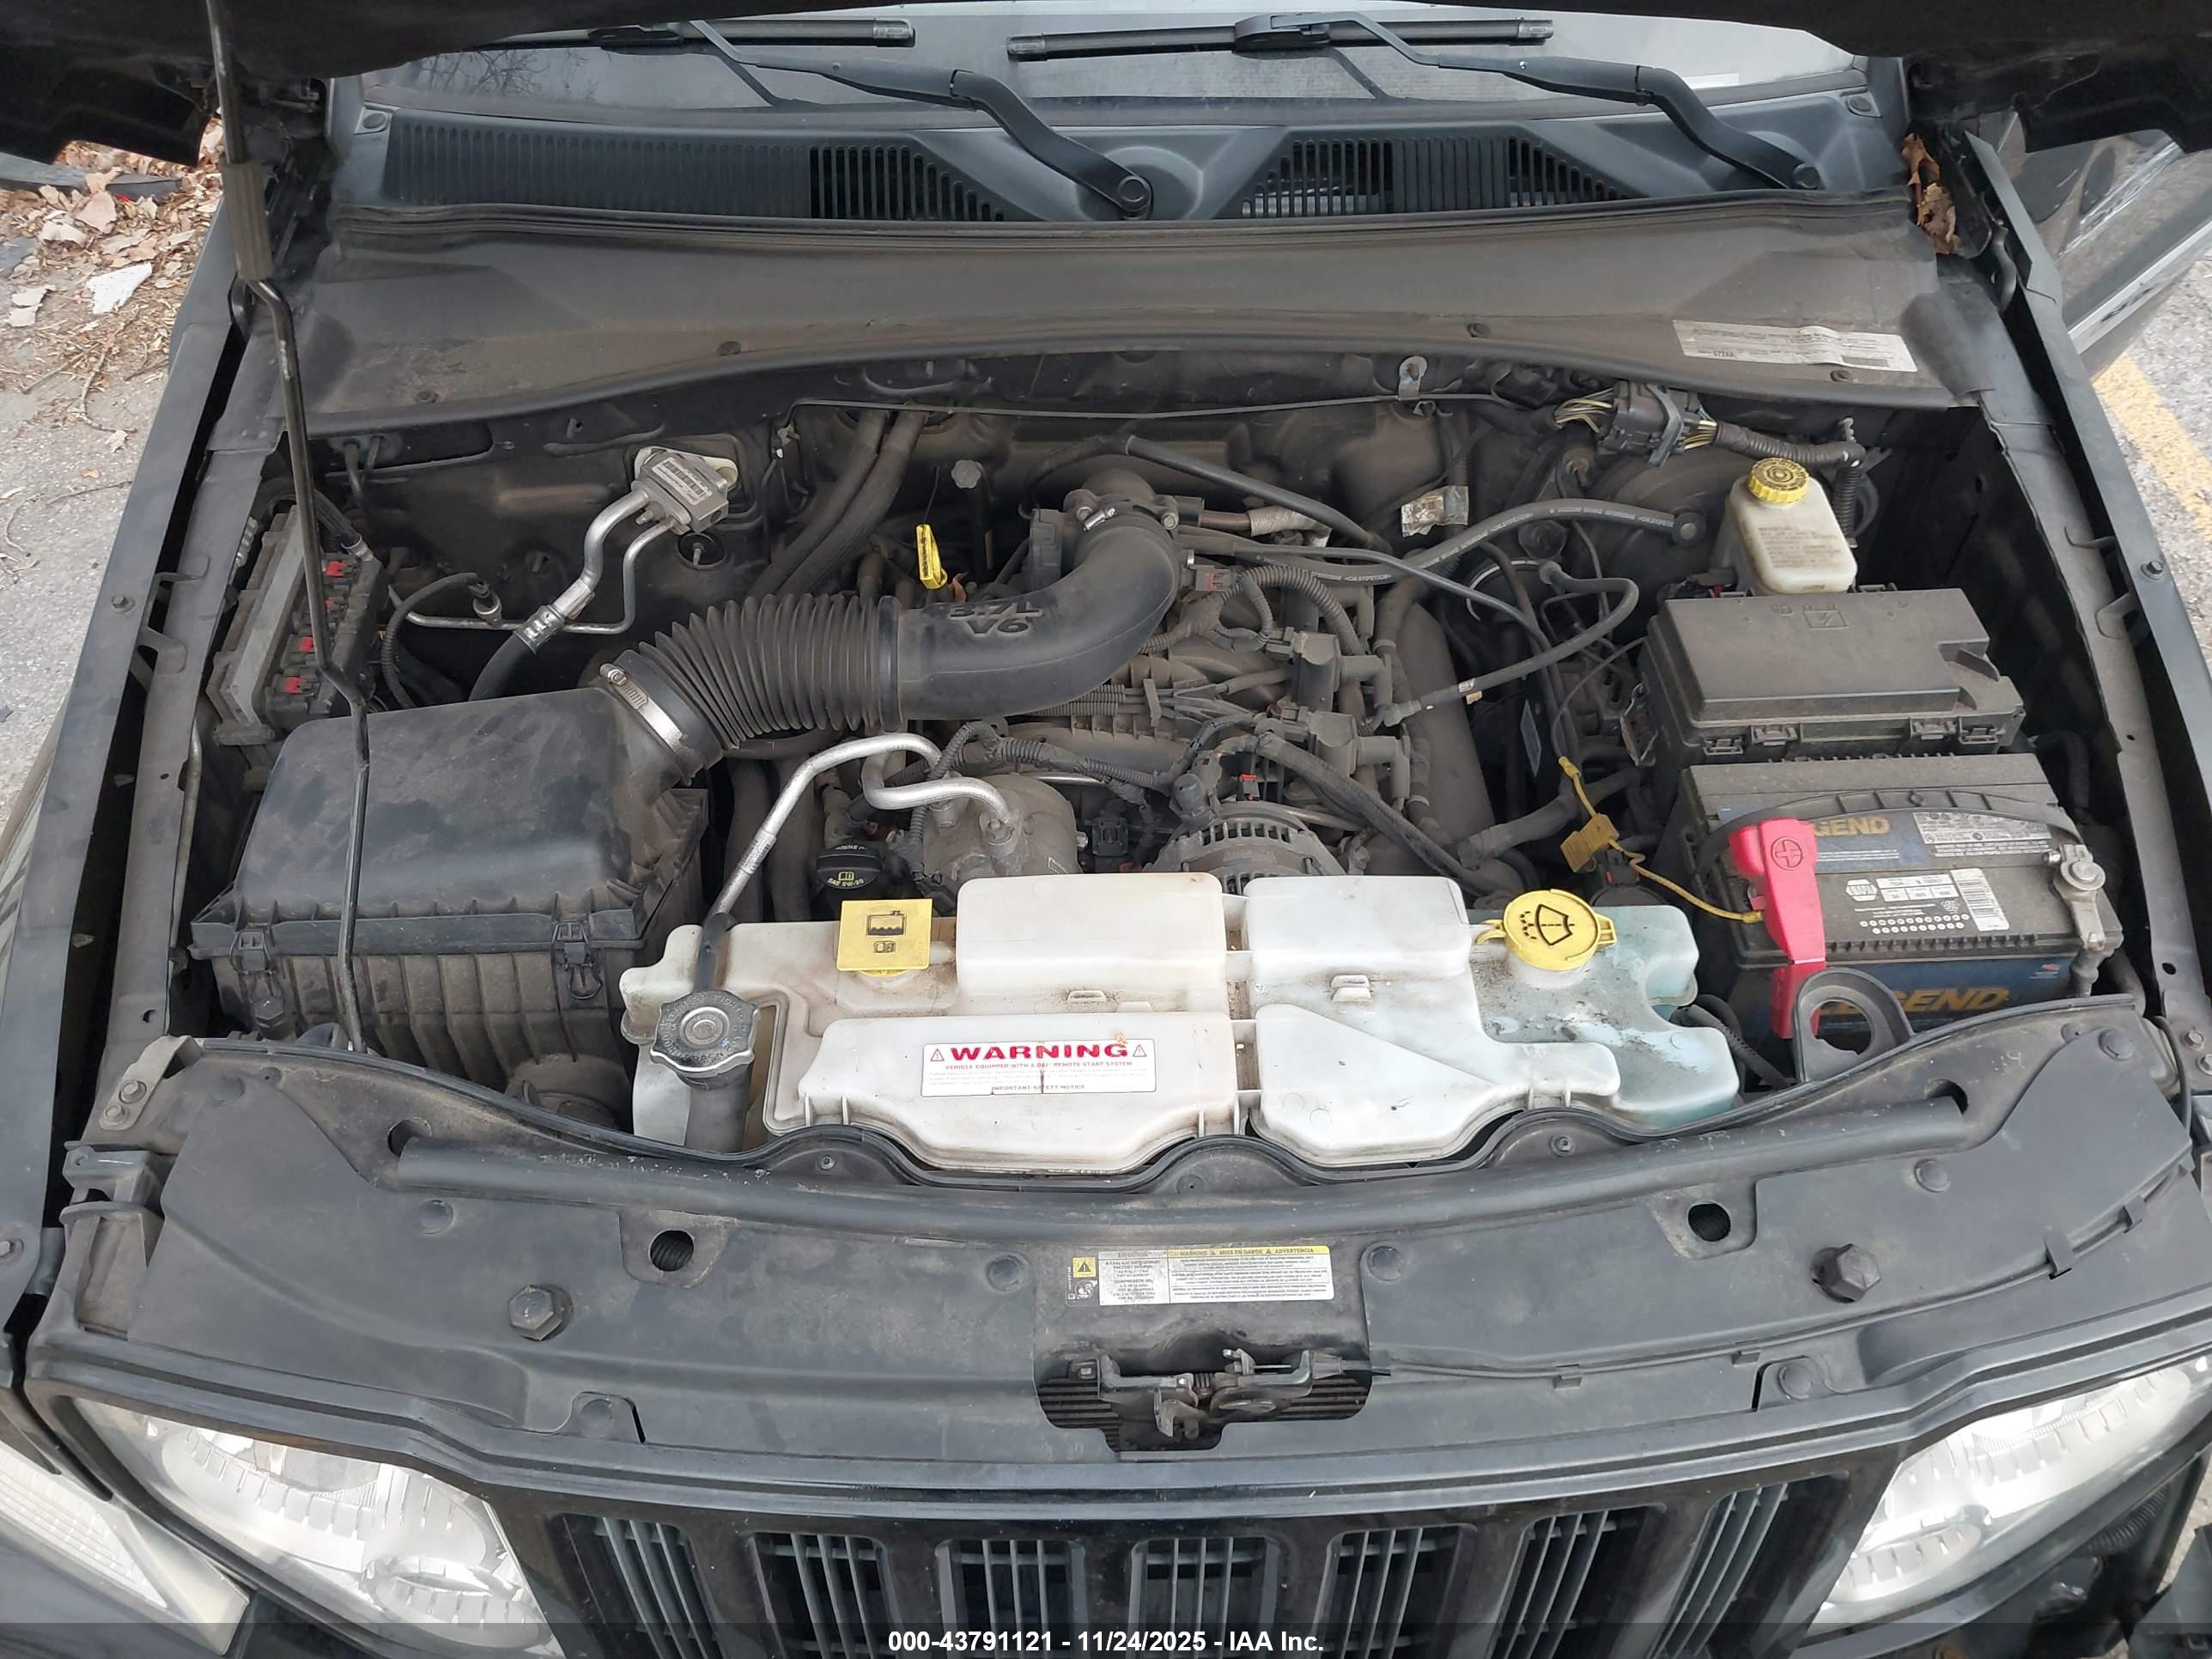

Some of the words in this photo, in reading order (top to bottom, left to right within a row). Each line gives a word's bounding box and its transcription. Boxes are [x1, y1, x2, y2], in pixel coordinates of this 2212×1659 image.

[950, 603, 1043, 618] 3.7L
[966, 617, 1029, 635] V6
[1814, 817, 1890, 837] GEND
[827, 878, 841, 886] SAE
[842, 878, 865, 887] 5W-20
[951, 1044, 1128, 1060] WARNING
